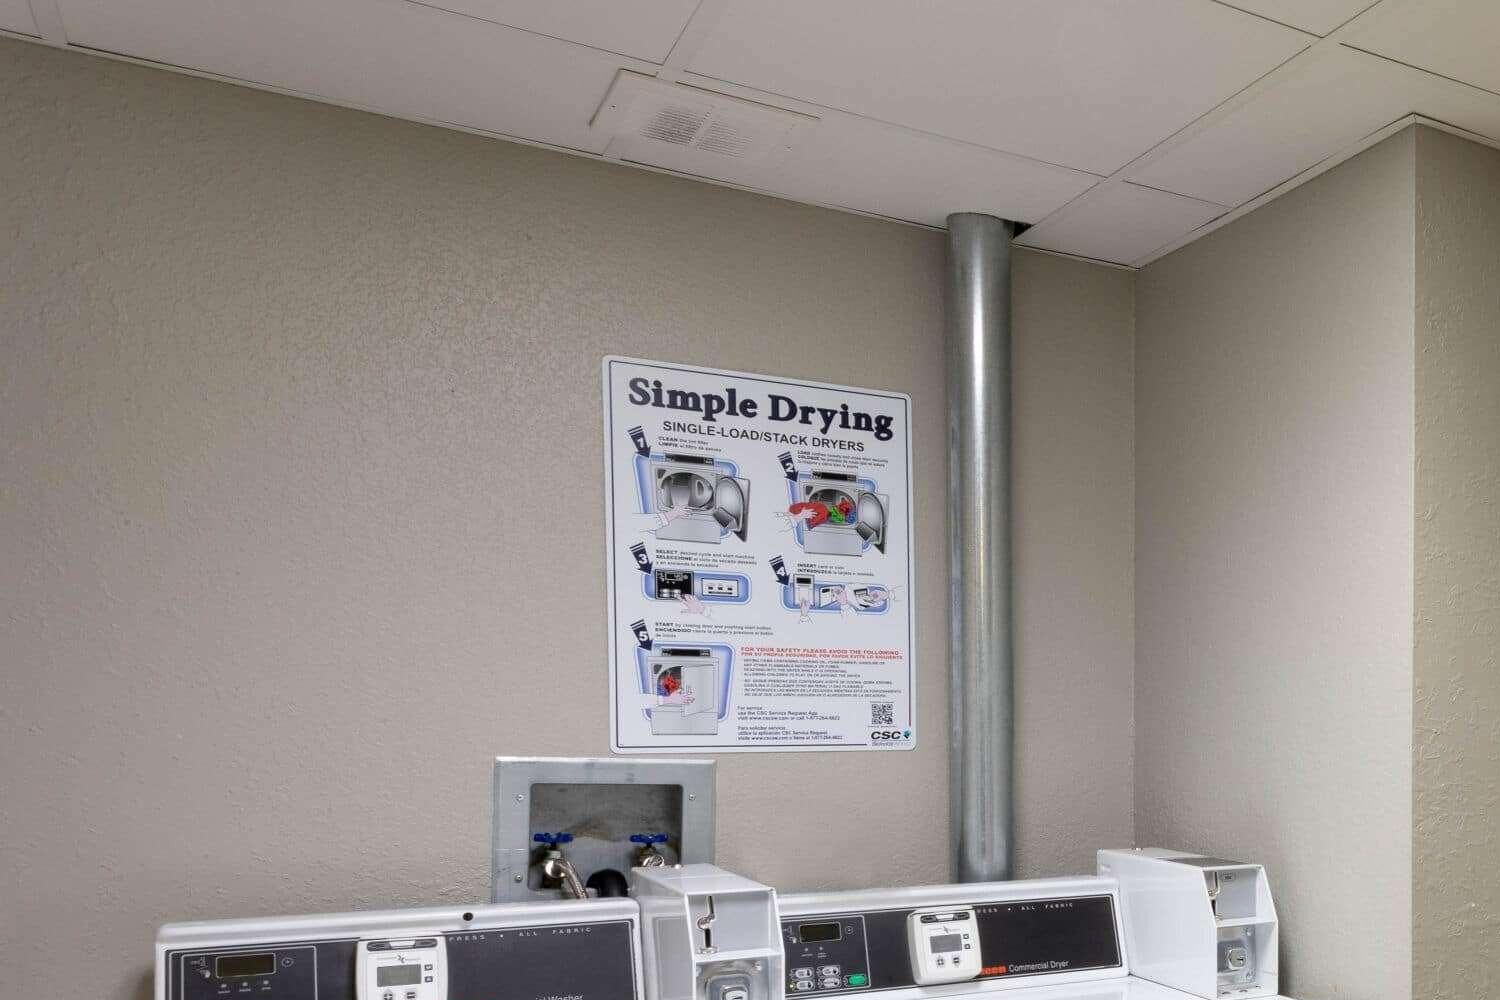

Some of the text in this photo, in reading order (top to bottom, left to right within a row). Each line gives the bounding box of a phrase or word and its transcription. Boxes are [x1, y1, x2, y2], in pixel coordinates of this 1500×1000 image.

[628, 377, 895, 442] Simple Drying
[662, 420, 809, 447] SINGLE-LOAD/STACK
[811, 437, 865, 453] DRYERS
[638, 553, 648, 565] 3
[638, 630, 648, 642] 5
[870, 730, 901, 740] CSC
[1009, 960, 1070, 973] Commercial Dryer
